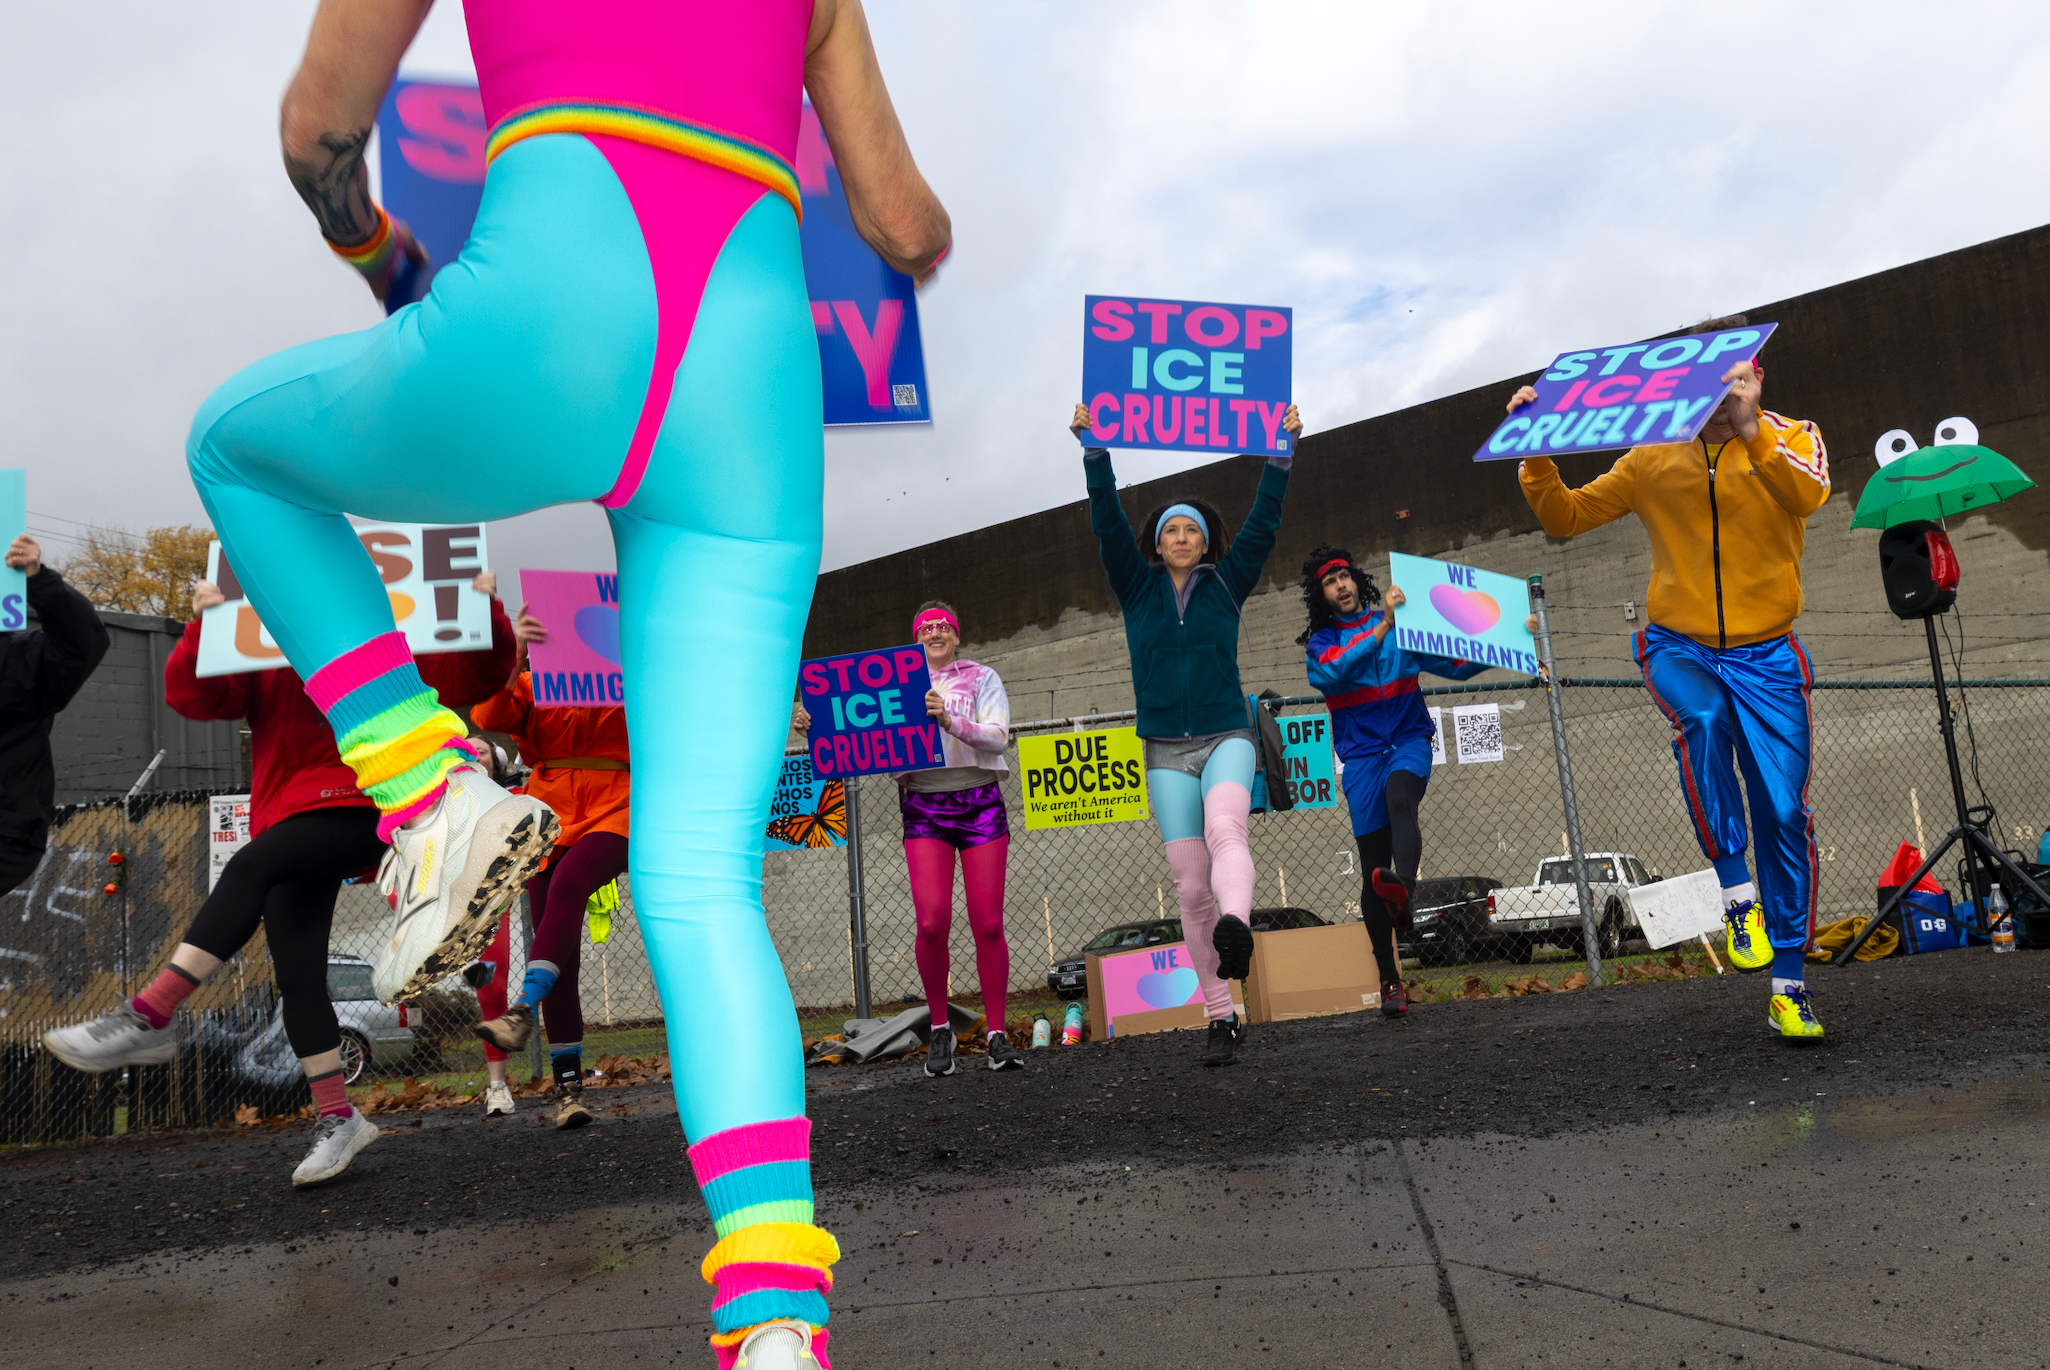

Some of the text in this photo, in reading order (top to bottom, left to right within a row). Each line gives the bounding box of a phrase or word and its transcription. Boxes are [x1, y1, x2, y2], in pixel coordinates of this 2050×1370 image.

[1092, 300, 1288, 349] STOP
[1132, 346, 1245, 394] ICE
[1545, 330, 1760, 382] STOP
[1553, 367, 1691, 412] ICE
[1089, 392, 1287, 449] CRUELTY
[1488, 395, 1712, 454] CRUELTY
[1446, 562, 1477, 589] WE
[802, 649, 924, 696] STOP
[1399, 627, 1537, 675] IMMIGRANTS
[831, 688, 905, 731] ICE
[1287, 719, 1325, 744] OFF
[813, 723, 935, 775] CRUELTY
[1055, 735, 1108, 765] DUE
[1027, 759, 1141, 798] PROCESS
[1030, 793, 1141, 812] We aren't America
[1053, 808, 1114, 823] without it
[417, 837, 436, 896] BROOKS
[1150, 948, 1179, 971] WE
